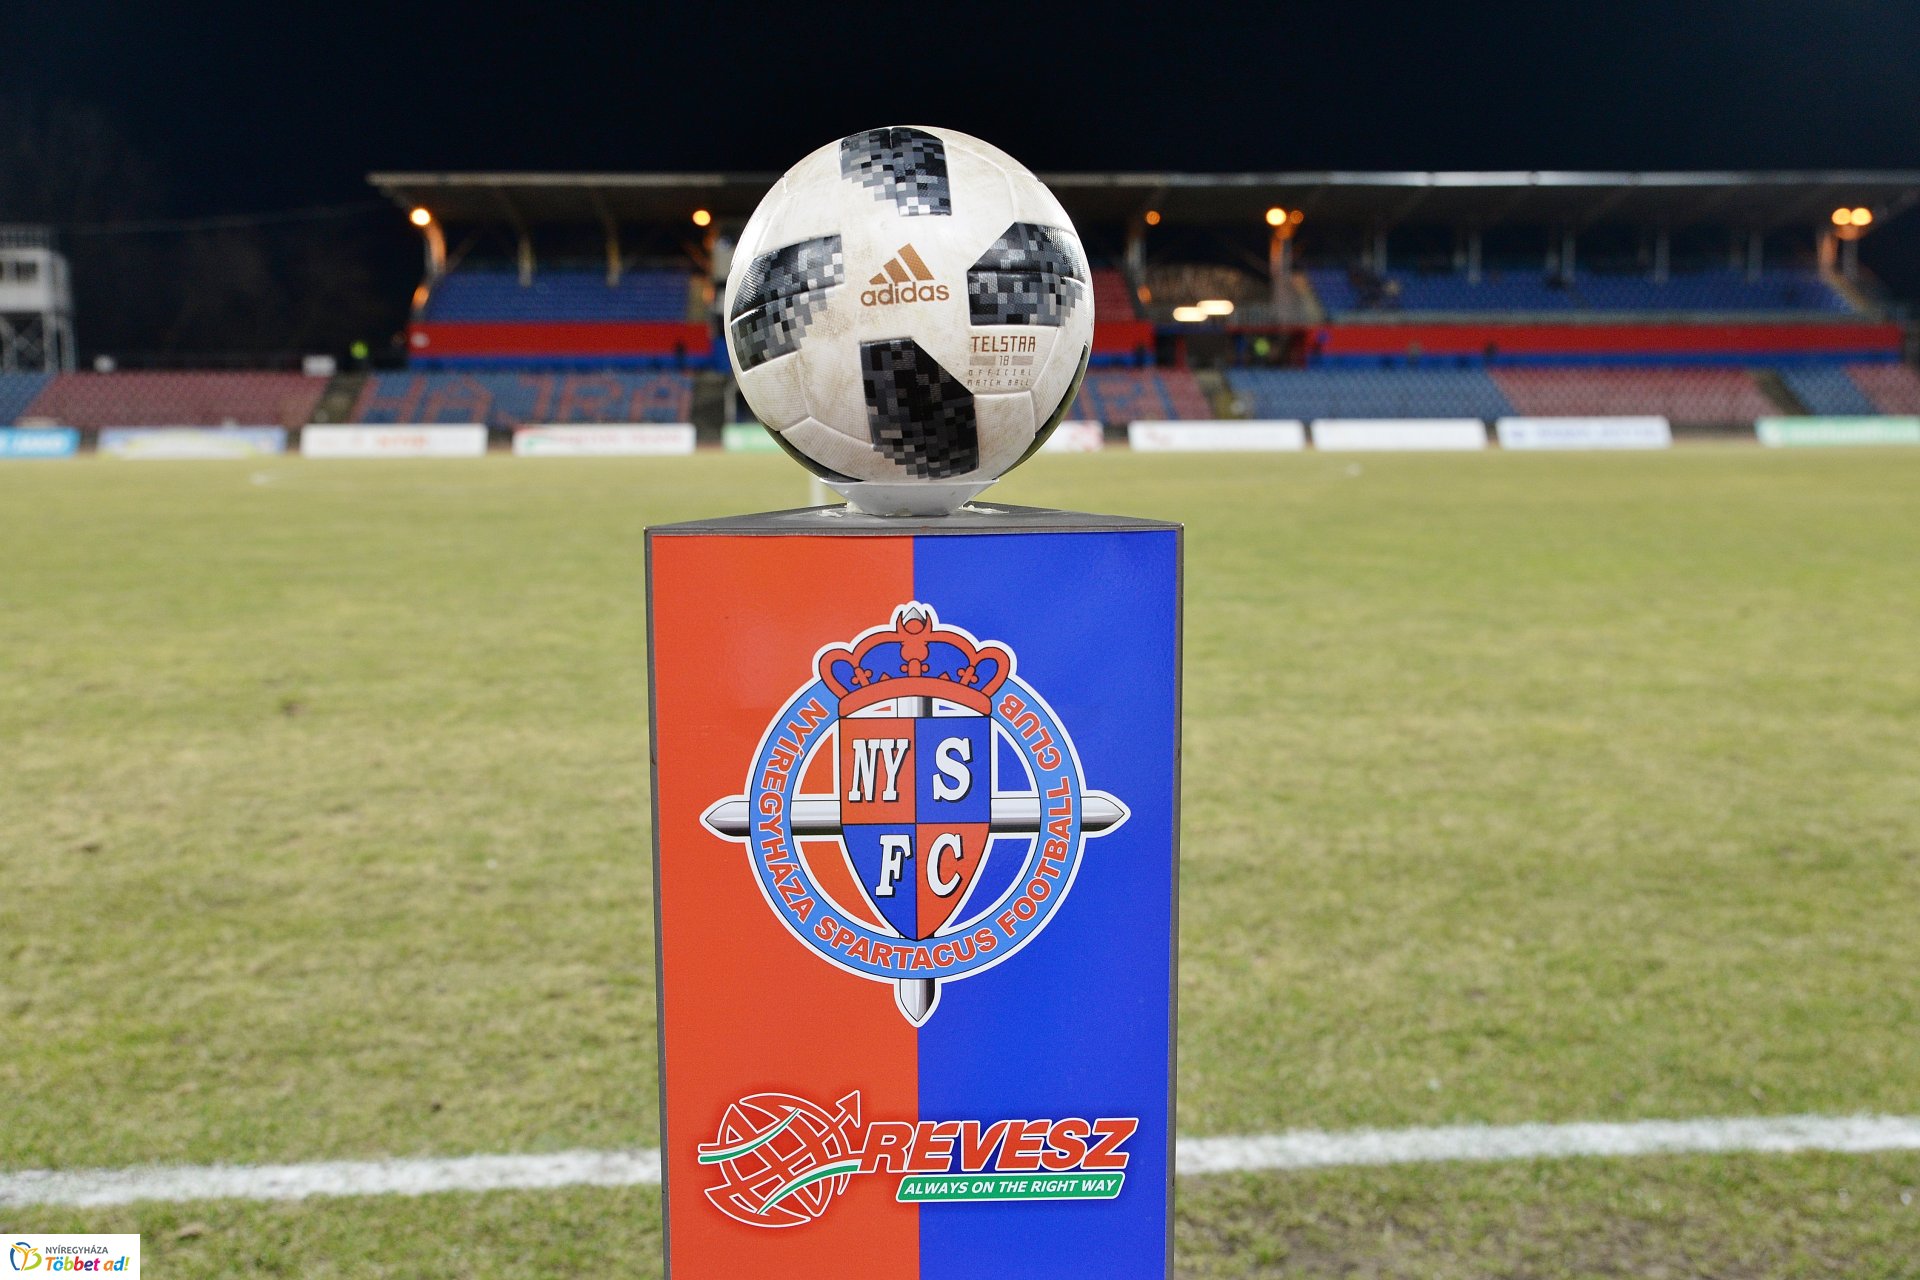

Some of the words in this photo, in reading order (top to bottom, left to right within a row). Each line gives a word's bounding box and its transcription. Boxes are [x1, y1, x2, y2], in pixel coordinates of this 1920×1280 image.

[860, 281, 950, 307] adidas
[970, 335, 1036, 353] TELSTAR
[999, 355, 1010, 367] 18
[966, 378, 1002, 387] MATCH
[1007, 378, 1030, 387] BALL
[968, 368, 1032, 377] OFFICIAL
[996, 691, 1063, 771] CLUB
[847, 737, 911, 803] NY
[932, 736, 974, 804] S
[757, 695, 830, 924] NYÍREGYHÁZA
[874, 833, 912, 898] F
[925, 832, 964, 899] C
[995, 776, 1073, 938] FOOTBALL
[813, 914, 998, 971] SPARTACUS
[858, 1117, 1139, 1173] REVESZ
[903, 1180, 968, 1195] ALWAYS
[971, 1180, 992, 1194] ON
[994, 1180, 1028, 1194] THE
[1030, 1179, 1077, 1194] RIGHT
[1081, 1178, 1118, 1193] WAY
